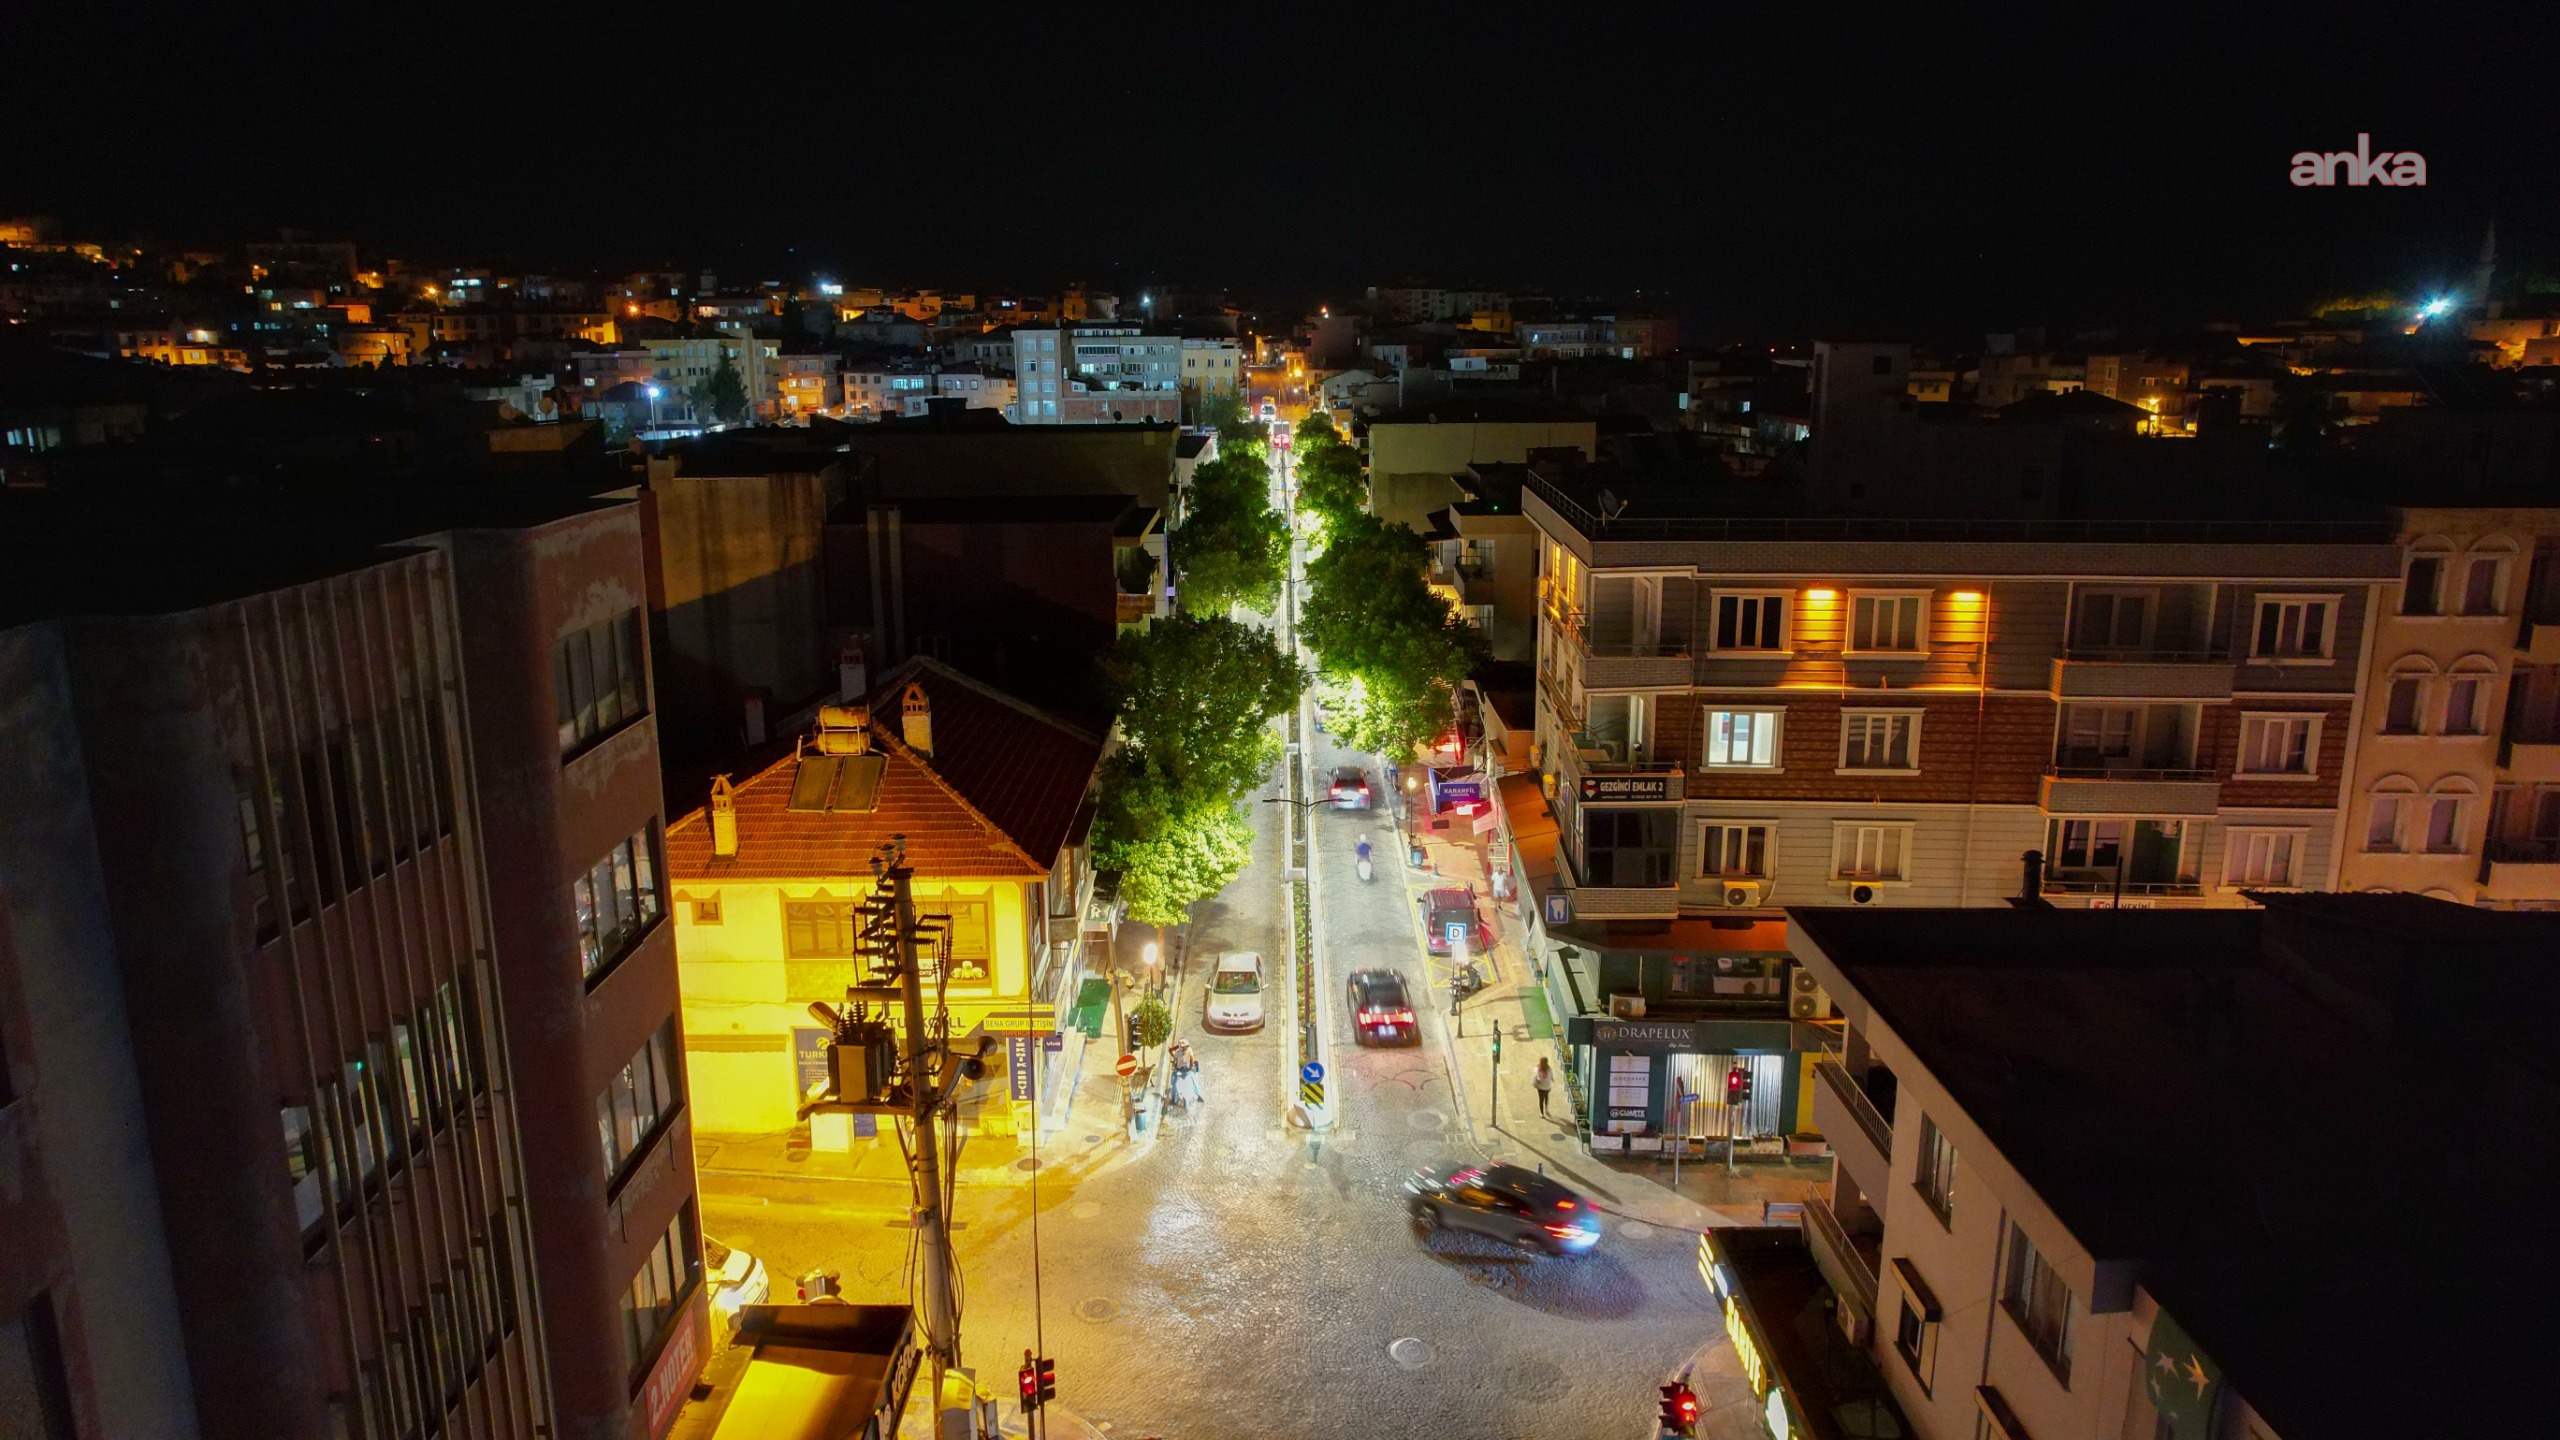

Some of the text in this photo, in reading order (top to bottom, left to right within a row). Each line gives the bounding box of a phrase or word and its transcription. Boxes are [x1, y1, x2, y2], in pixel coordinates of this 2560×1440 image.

[1600, 779, 1663, 792] GEZGİNCİ EMLAK 2
[1453, 928, 1459, 938] D
[985, 1020, 1003, 1028] SENA
[1006, 1020, 1024, 1028] GRUP
[1619, 1027, 1690, 1039] DRAPELUX
